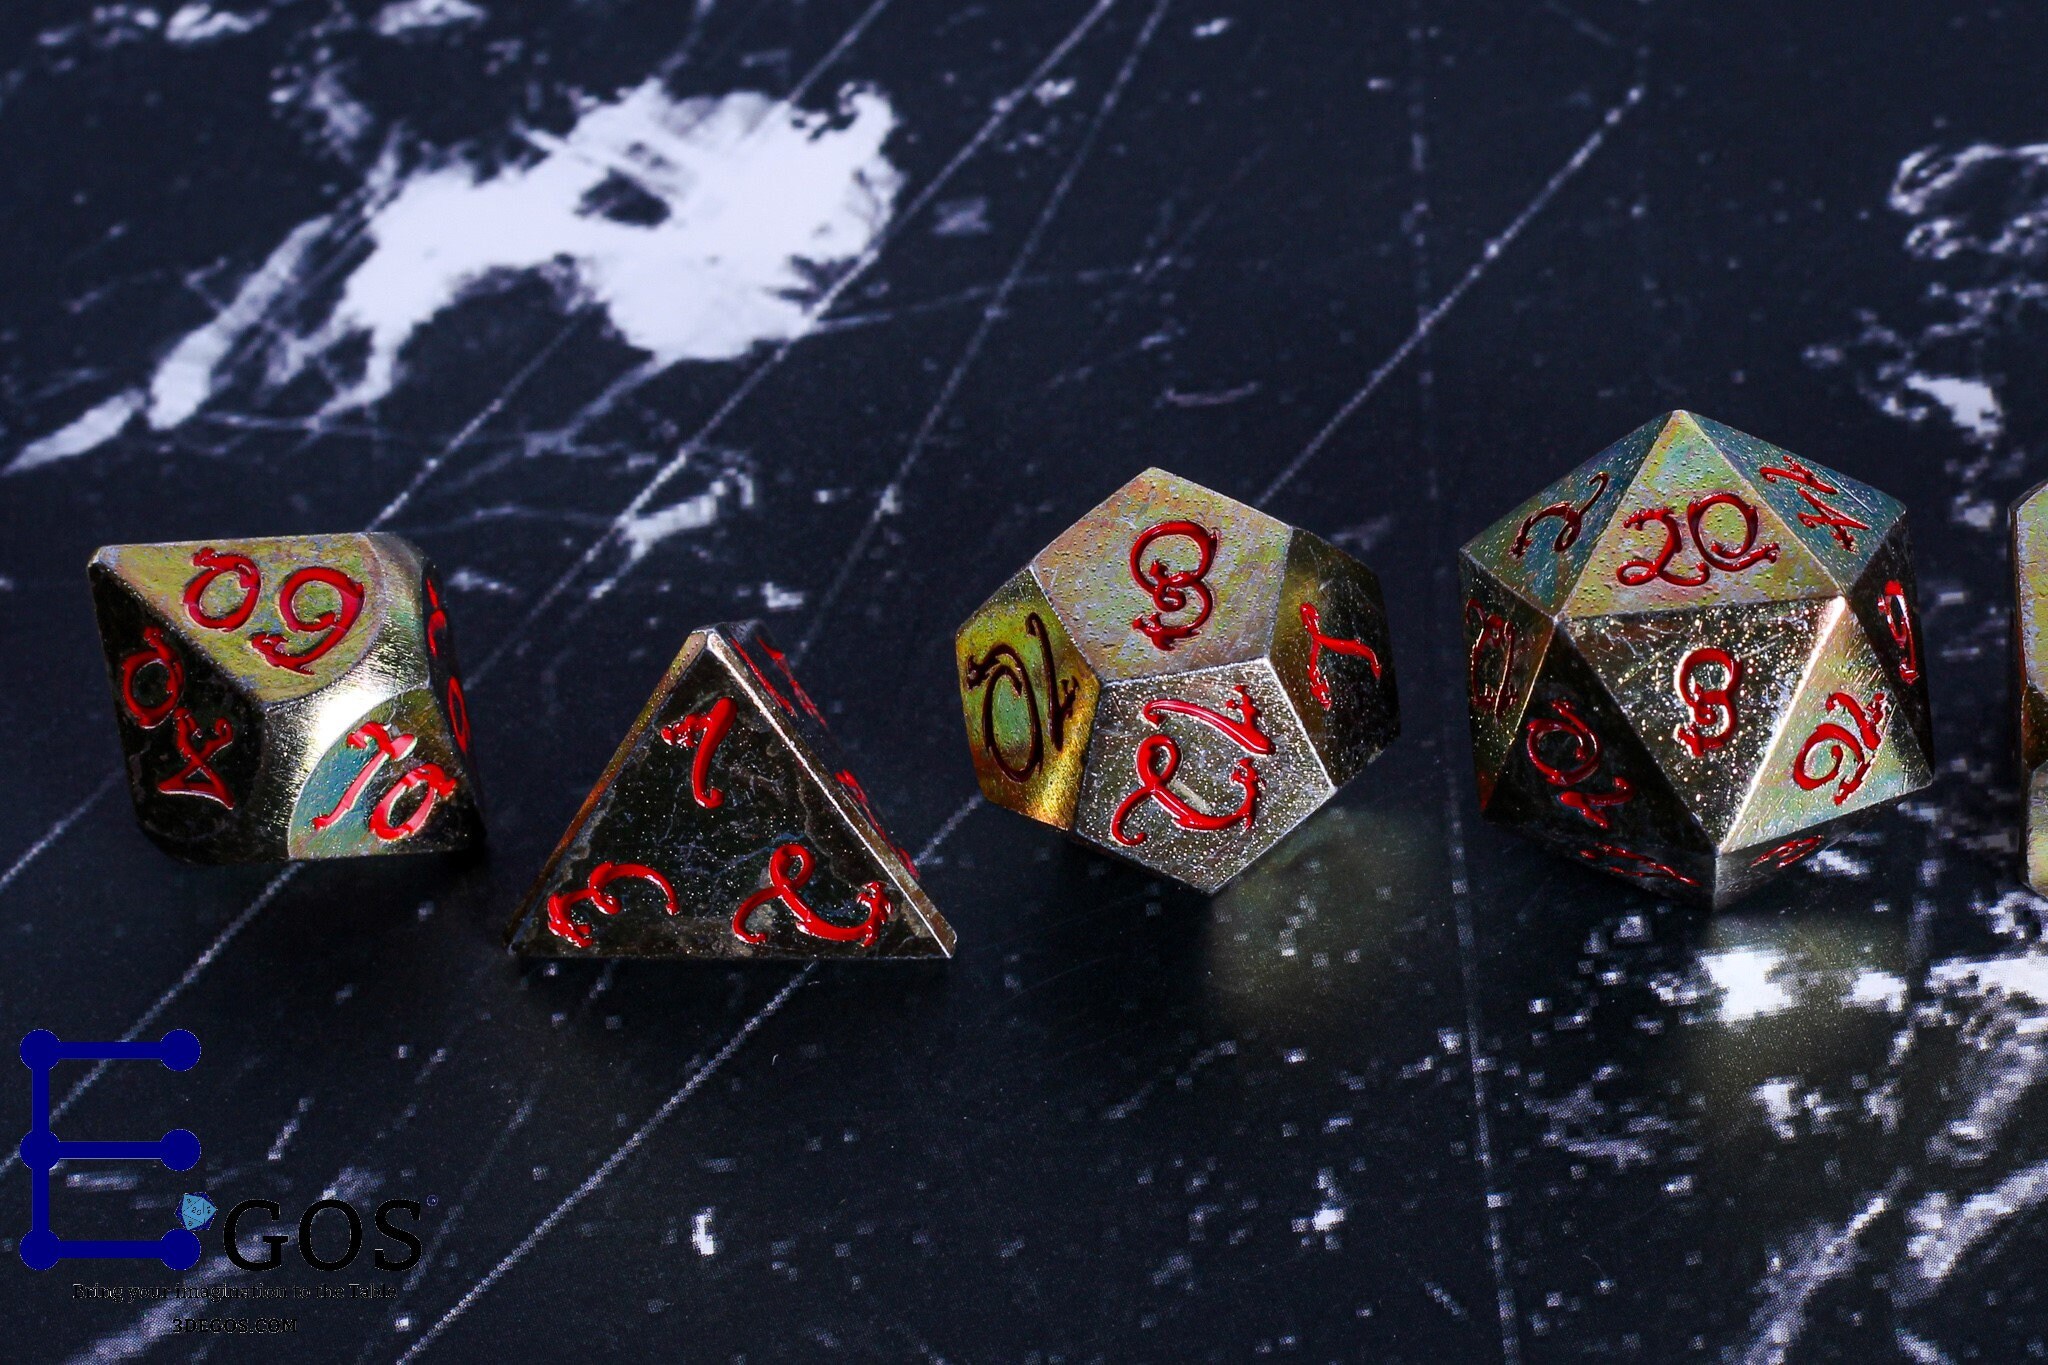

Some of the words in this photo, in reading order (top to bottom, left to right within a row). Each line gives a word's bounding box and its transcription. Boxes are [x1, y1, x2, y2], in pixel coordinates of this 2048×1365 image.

[1510, 471, 1609, 557] 2
[1616, 492, 1780, 587] 20
[660, 696, 738, 808] 1
[1112, 685, 1276, 846] 12
[547, 861, 680, 948] 3
[732, 843, 893, 947] 2
